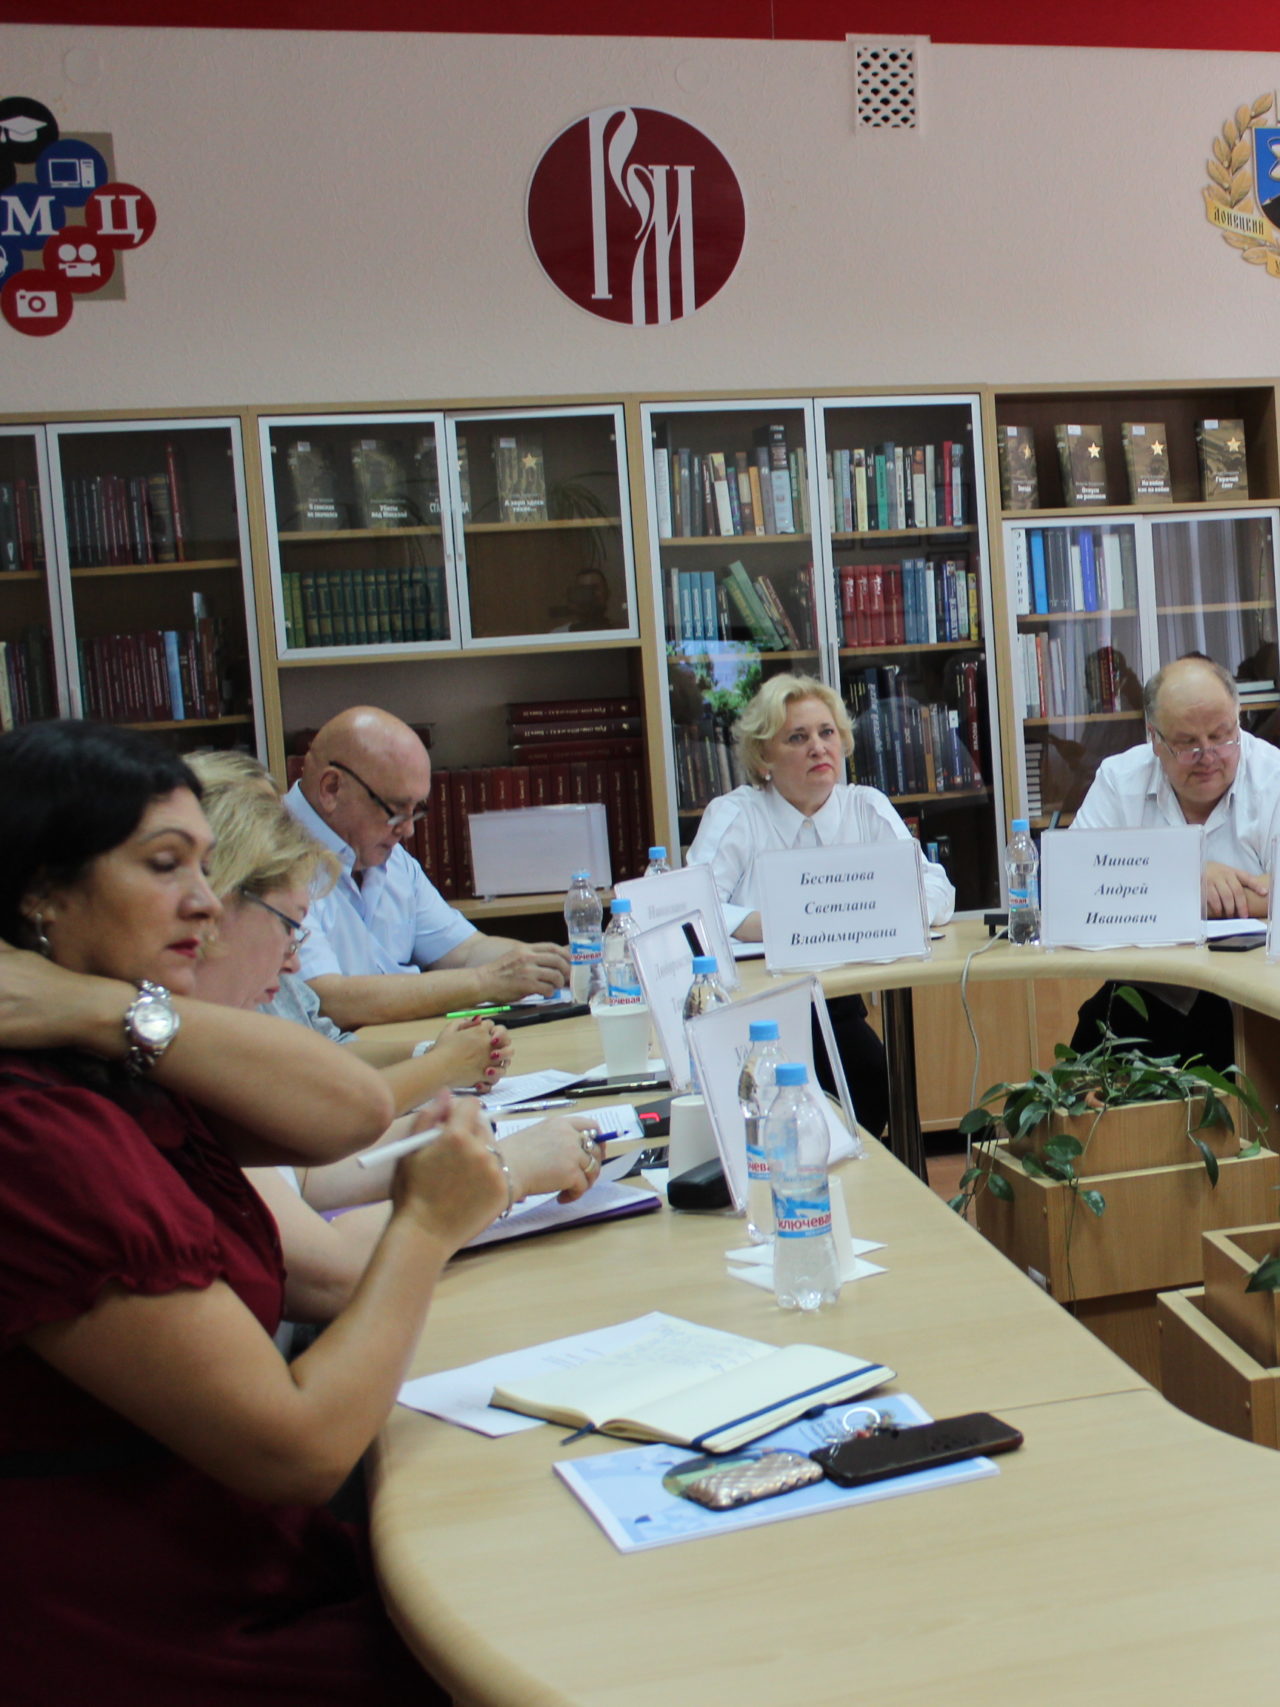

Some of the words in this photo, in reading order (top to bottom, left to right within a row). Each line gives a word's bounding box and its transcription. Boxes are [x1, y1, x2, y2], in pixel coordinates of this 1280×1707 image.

[1093, 854, 1151, 868] Минаев
[799, 870, 875, 886] Беспалова
[1094, 882, 1149, 899] Андрей
[804, 901, 876, 917] Светлана
[1085, 912, 1157, 925] Иванович
[790, 928, 898, 948] Владимировна
